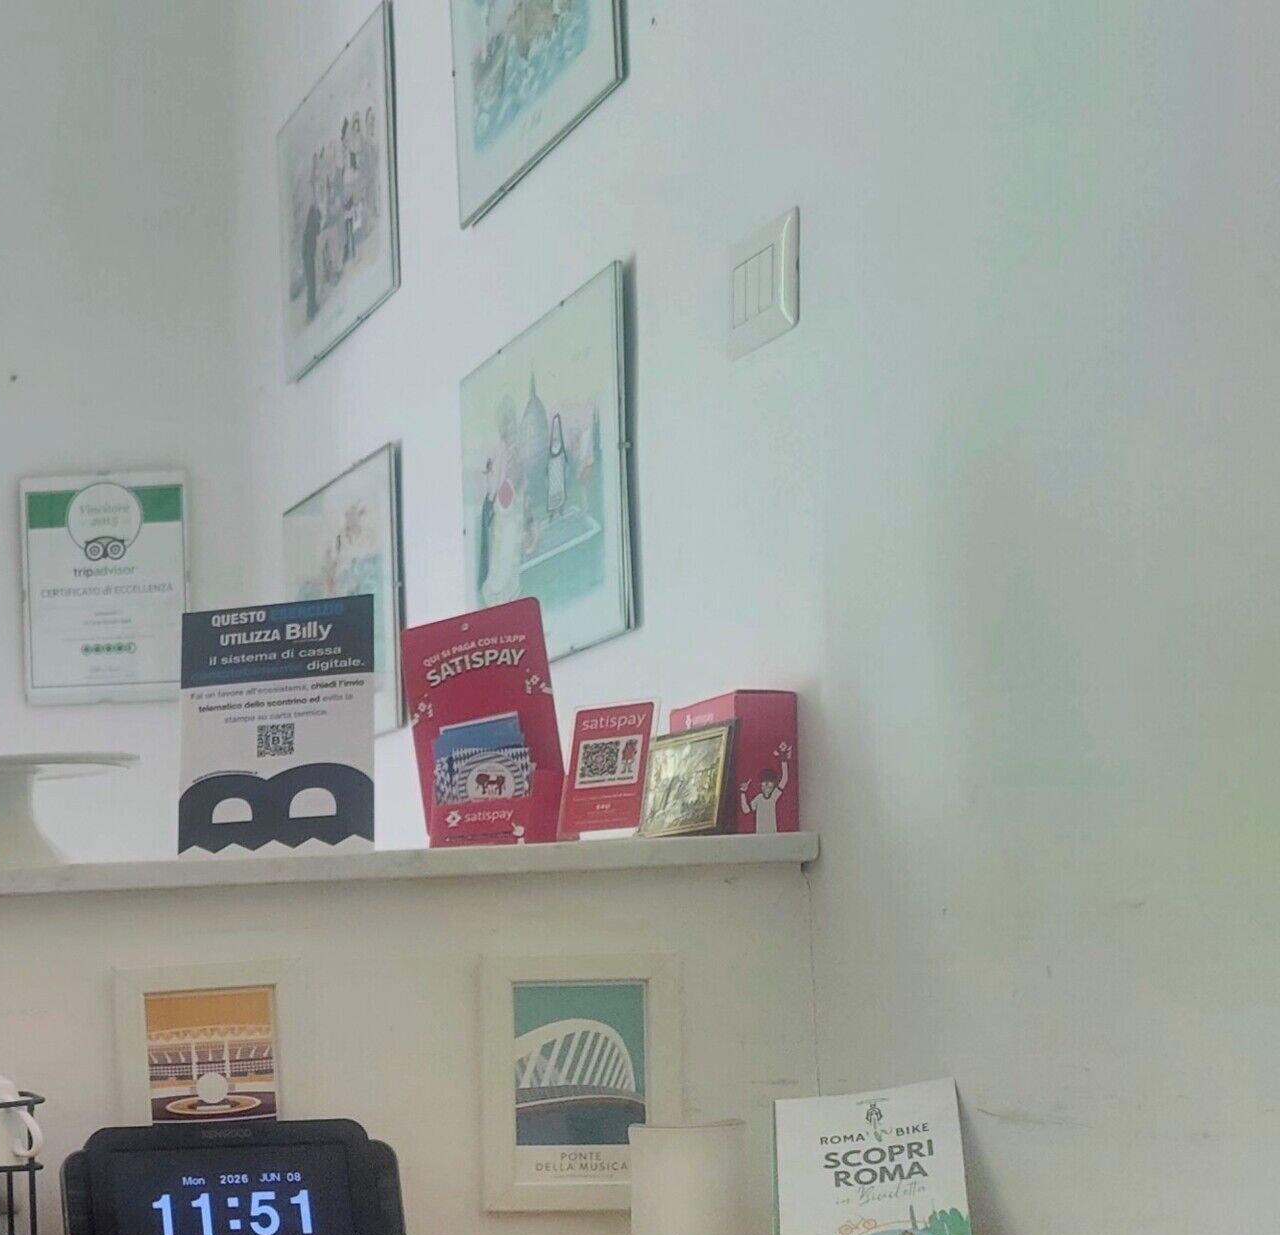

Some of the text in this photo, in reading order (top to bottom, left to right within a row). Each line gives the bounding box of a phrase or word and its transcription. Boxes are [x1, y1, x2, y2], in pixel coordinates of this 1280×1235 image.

[73, 564, 136, 579] tripadvisor
[41, 583, 174, 599] CERTIFICATO di ECCELLENZA
[211, 611, 267, 628] QUESTO
[219, 620, 333, 647] UTILIZZA Billy
[208, 645, 342, 667] il sistema di cassa
[422, 632, 527, 668] QUI SI PAGA CON L'APP
[306, 656, 366, 672] digitale.
[425, 648, 526, 689] SATISPAY
[310, 679, 337, 691] chiedi
[198, 700, 243, 713] telematico
[244, 699, 265, 709] dello
[267, 697, 308, 708] scontrino
[309, 694, 321, 704] ed
[580, 711, 647, 732] satispay
[463, 808, 515, 824] satispay
[819, 1122, 931, 1146] ROMA BIKE
[559, 1151, 603, 1162] PONTE
[823, 1138, 935, 1170] SCOPRI
[535, 1160, 629, 1172] DELLA MUSICA
[833, 1161, 929, 1189] ROMA
[181, 1171, 302, 1187] Mon 2026 JUN 08
